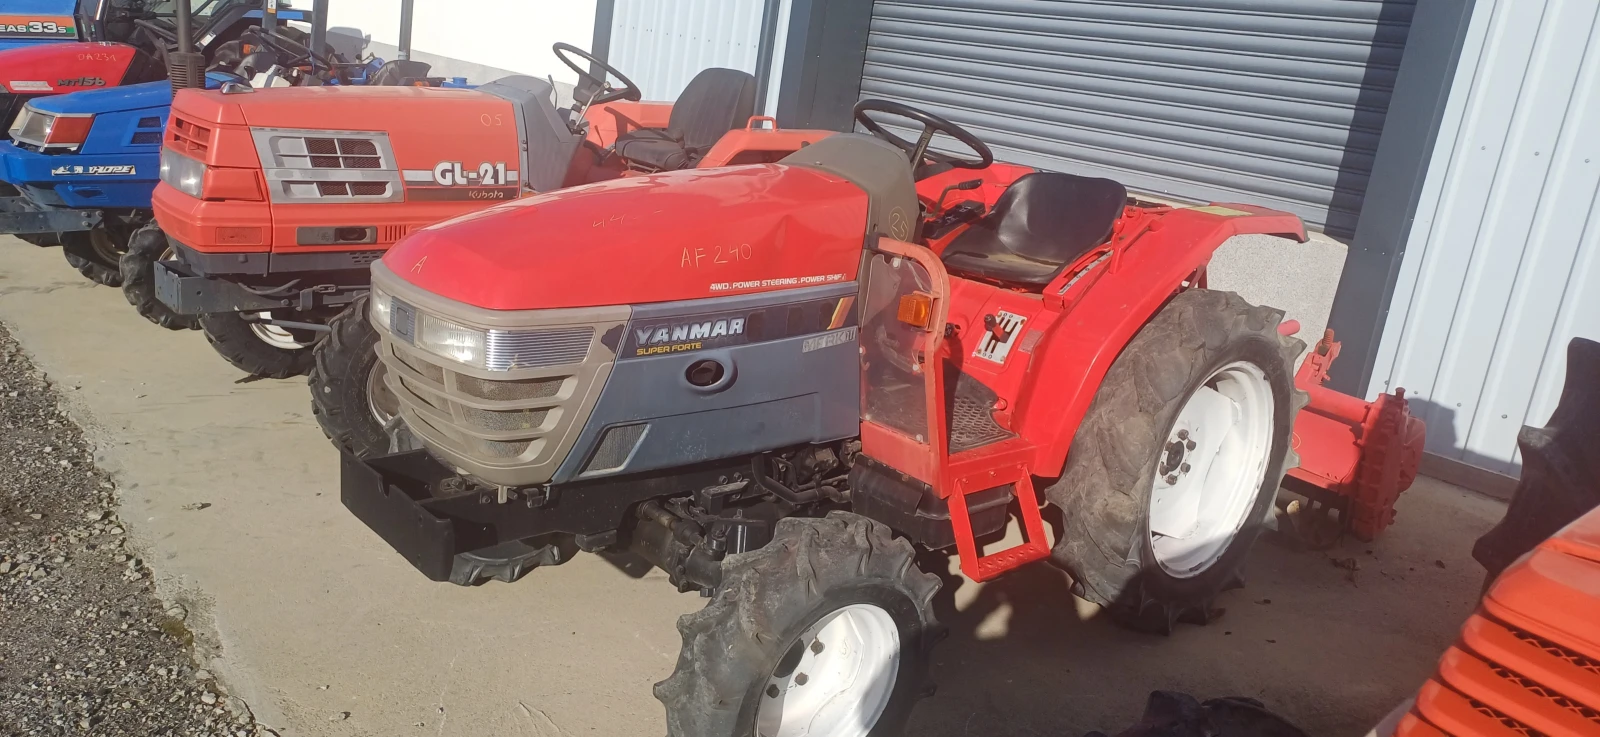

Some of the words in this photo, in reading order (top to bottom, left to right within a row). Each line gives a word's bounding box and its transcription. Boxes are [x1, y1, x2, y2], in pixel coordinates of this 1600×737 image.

[434, 161, 506, 186] GL-21
[468, 190, 504, 199] Kubota
[680, 246, 706, 269] AF
[636, 318, 745, 344] YANMAR
[636, 346, 669, 356] SUPER
[671, 343, 702, 353] FORTE
